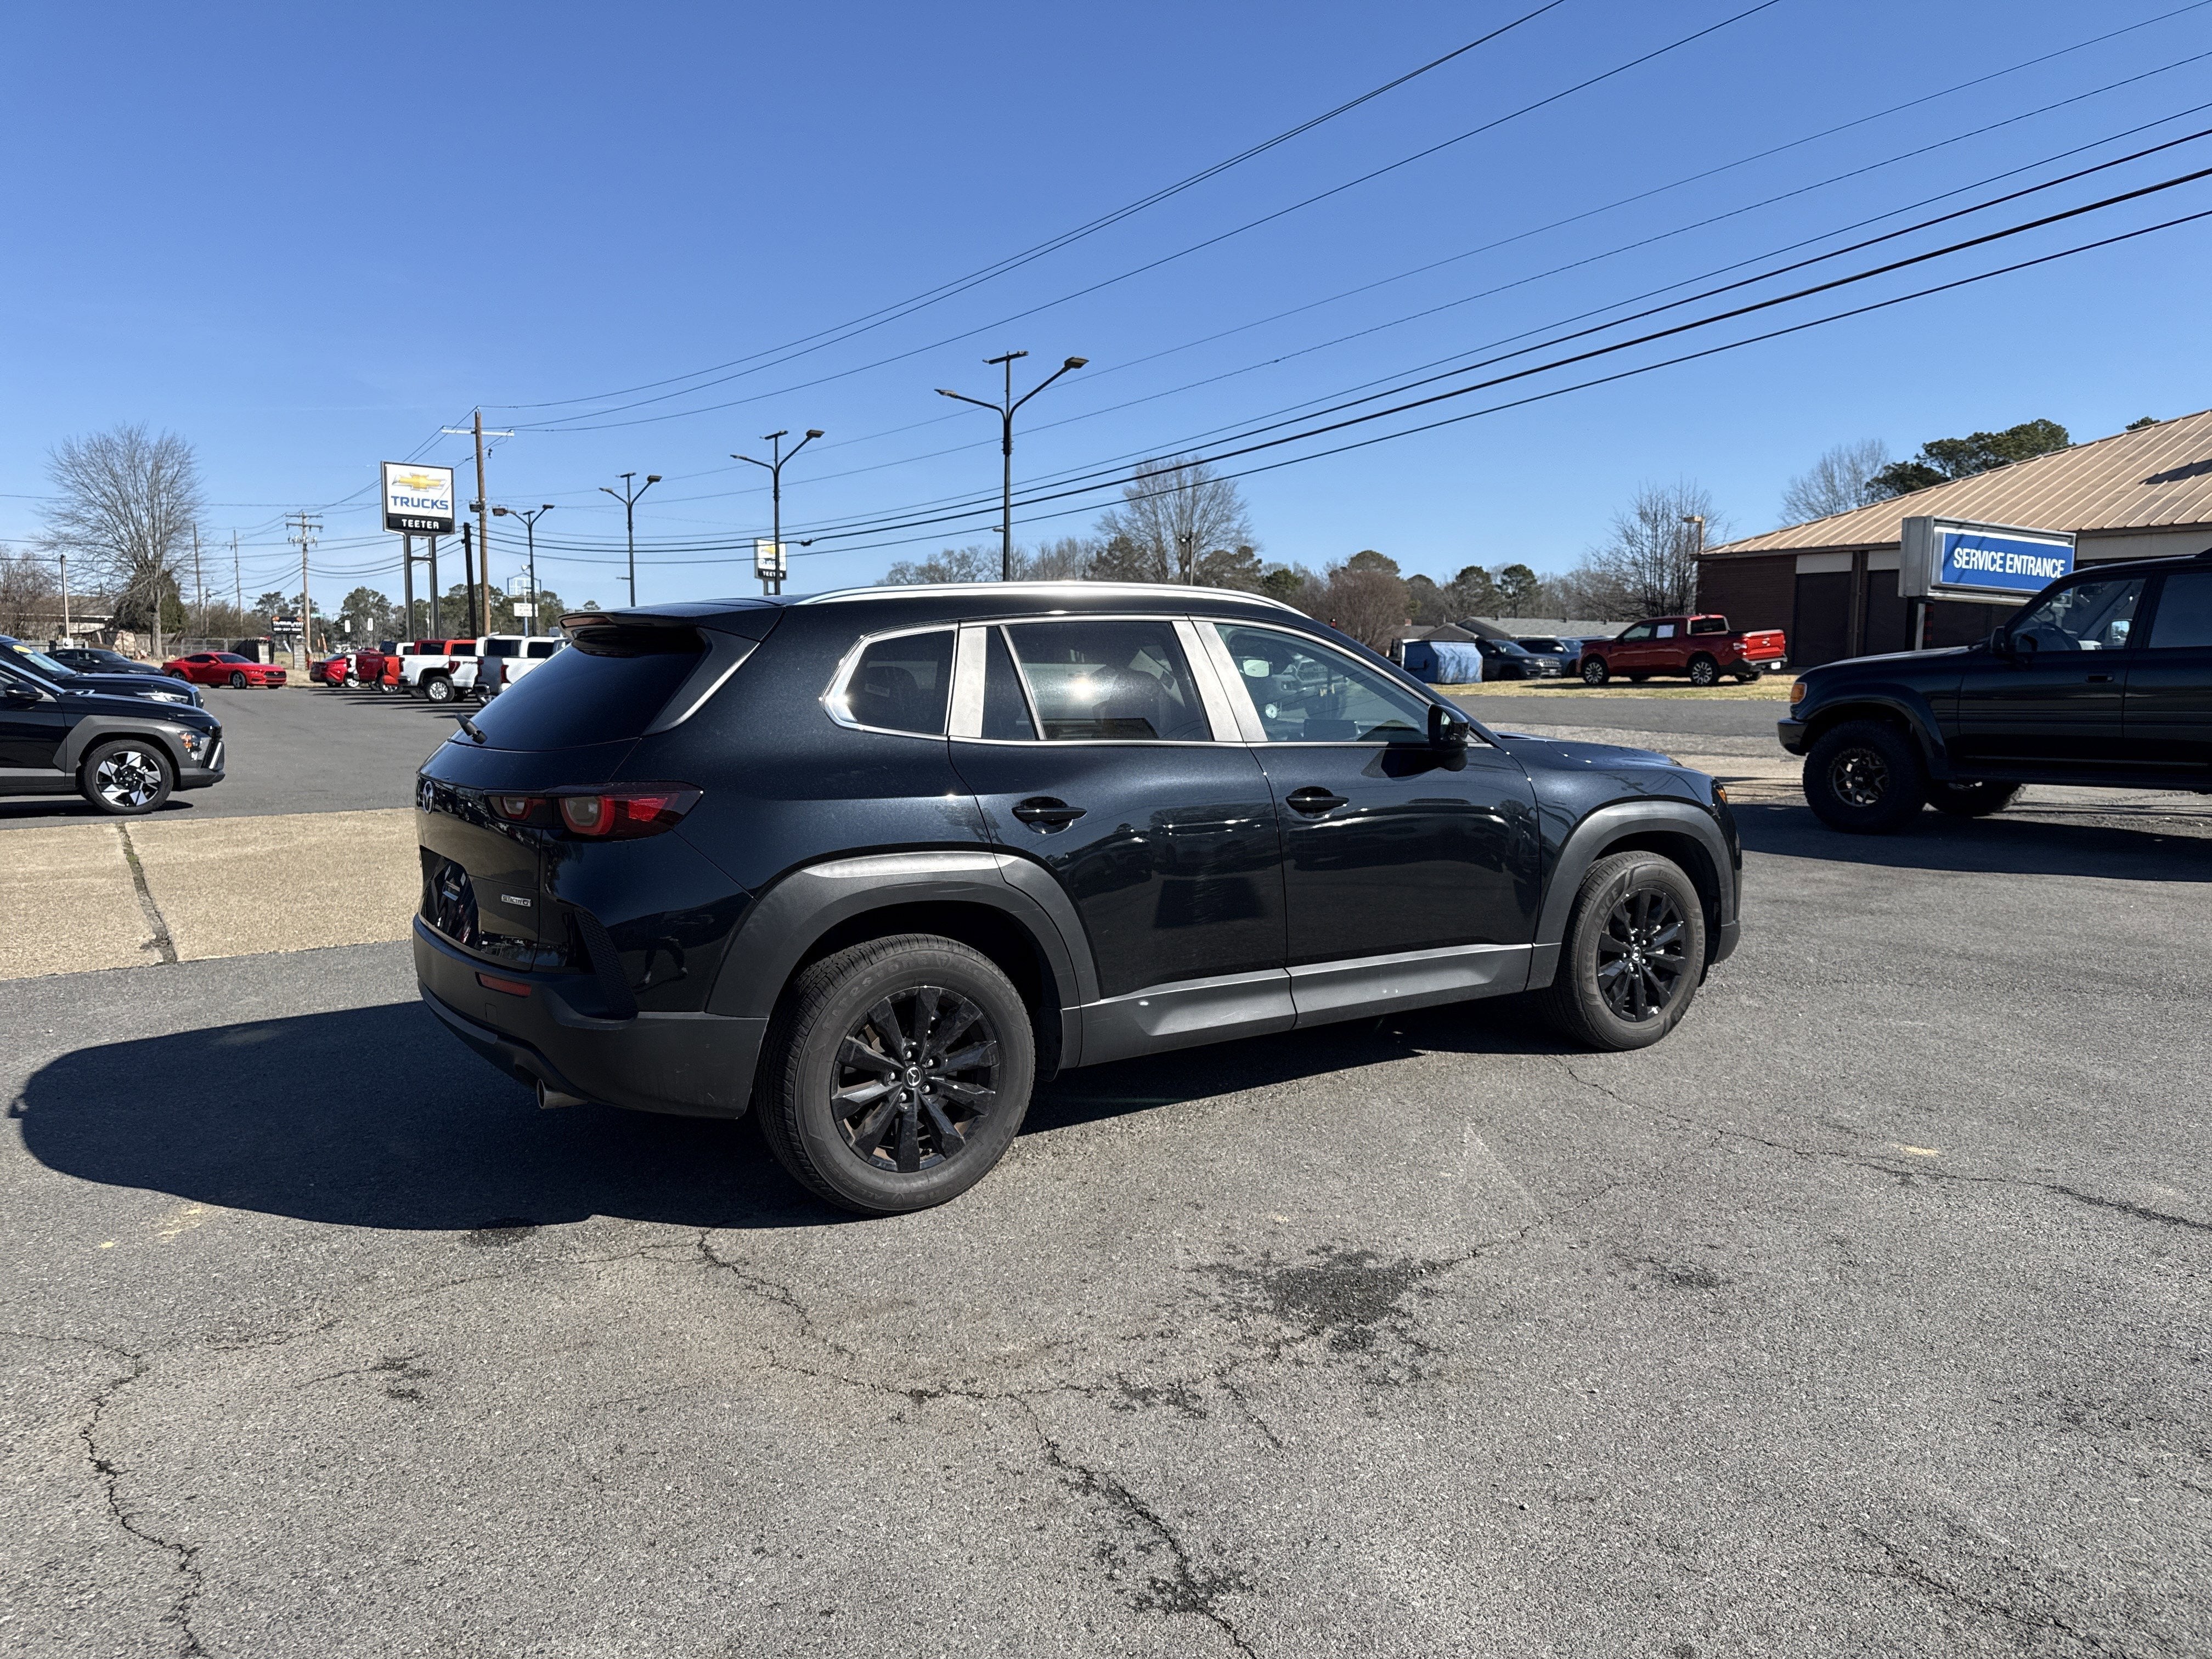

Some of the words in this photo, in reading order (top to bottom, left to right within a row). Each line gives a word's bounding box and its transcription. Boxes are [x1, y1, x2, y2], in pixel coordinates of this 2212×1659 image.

[391, 495, 448, 510] TRUCKS
[402, 518, 439, 529] TEETER
[1953, 547, 2005, 572] SERVICE
[2005, 553, 2065, 578] ENTRANCE
[861, 1189, 884, 1201] ALL
